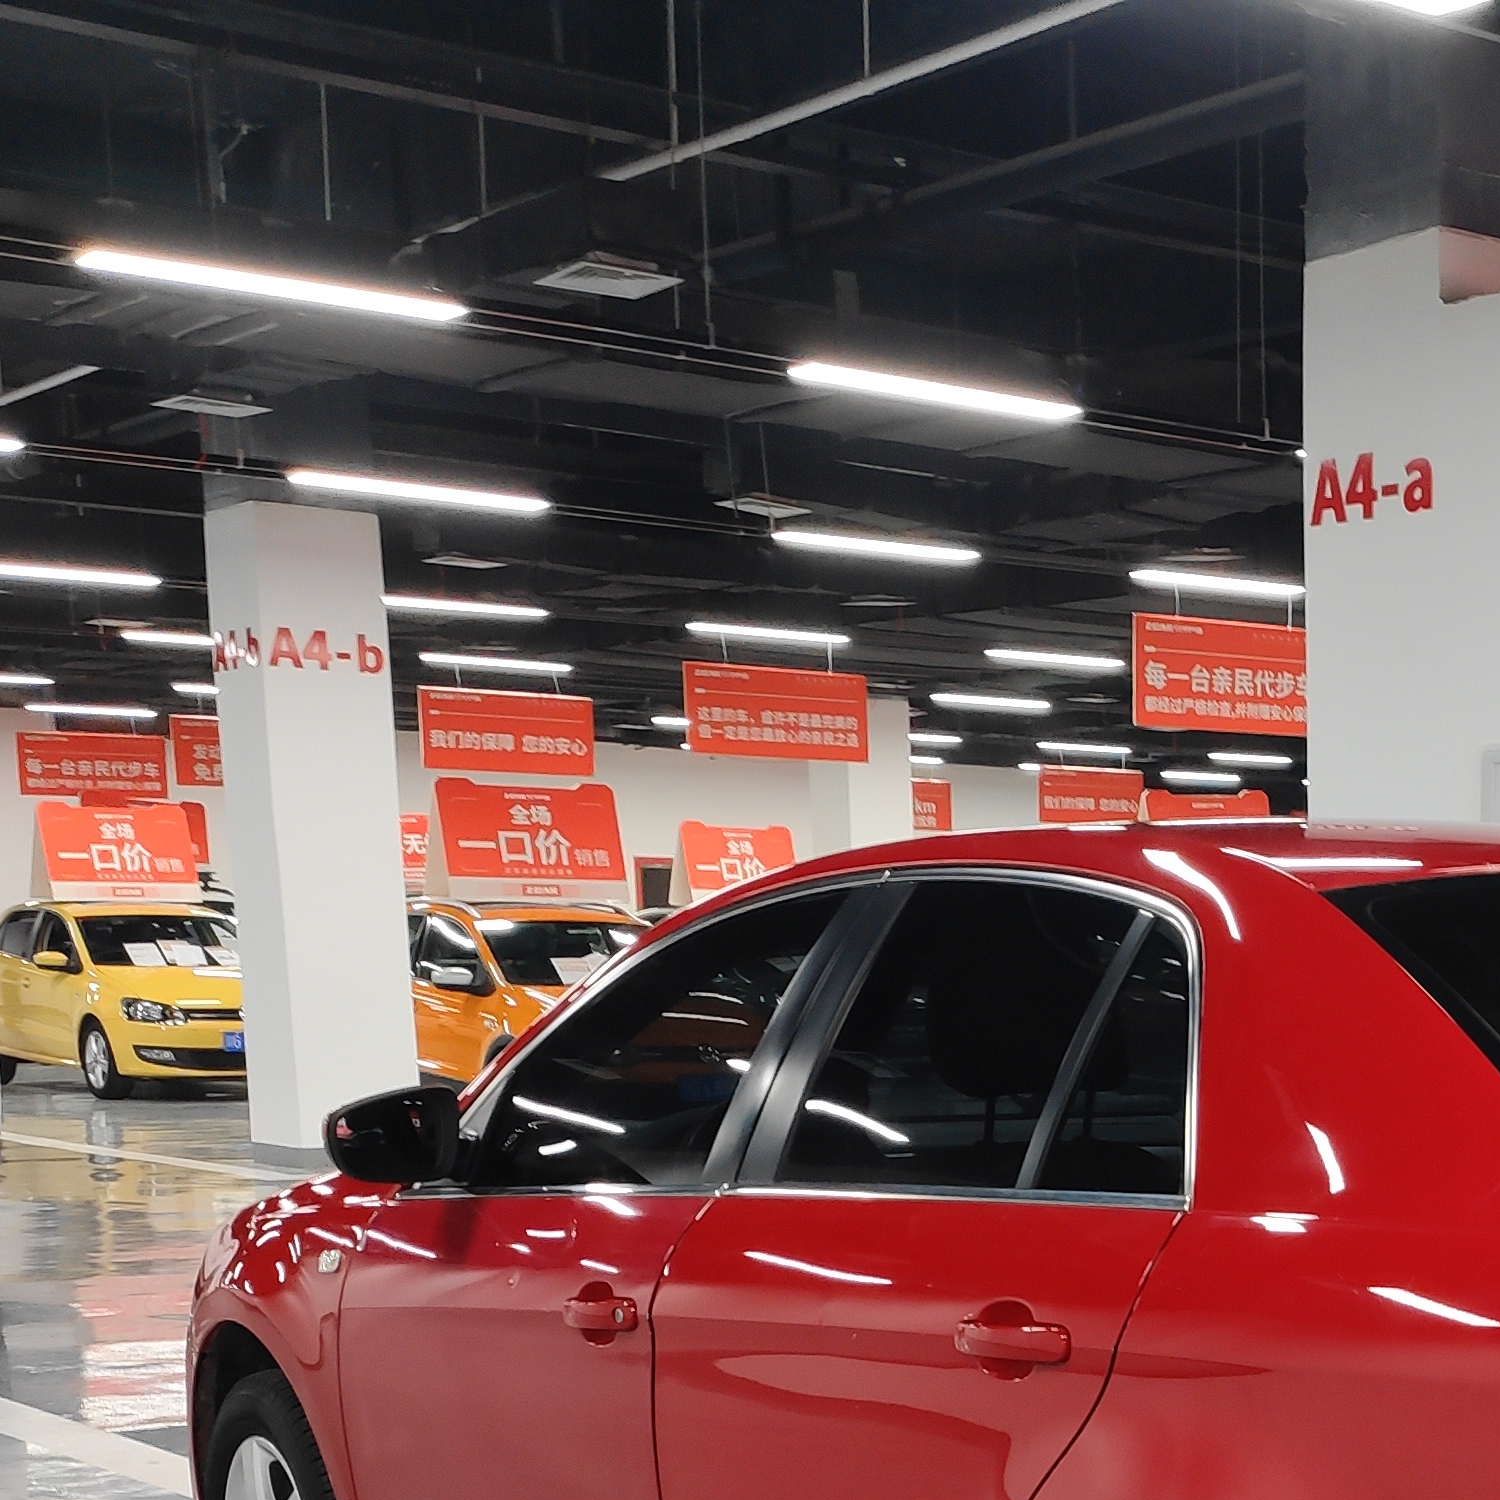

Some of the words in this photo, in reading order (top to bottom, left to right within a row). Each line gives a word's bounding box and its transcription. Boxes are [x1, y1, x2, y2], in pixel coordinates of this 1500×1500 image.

[1310, 452, 1434, 527] A4-a
[268, 627, 384, 674] A4-b
[98, 822, 135, 841] 全场
[507, 804, 552, 826] 全场
[57, 842, 152, 873] 一口价
[457, 829, 572, 866] 一口价
